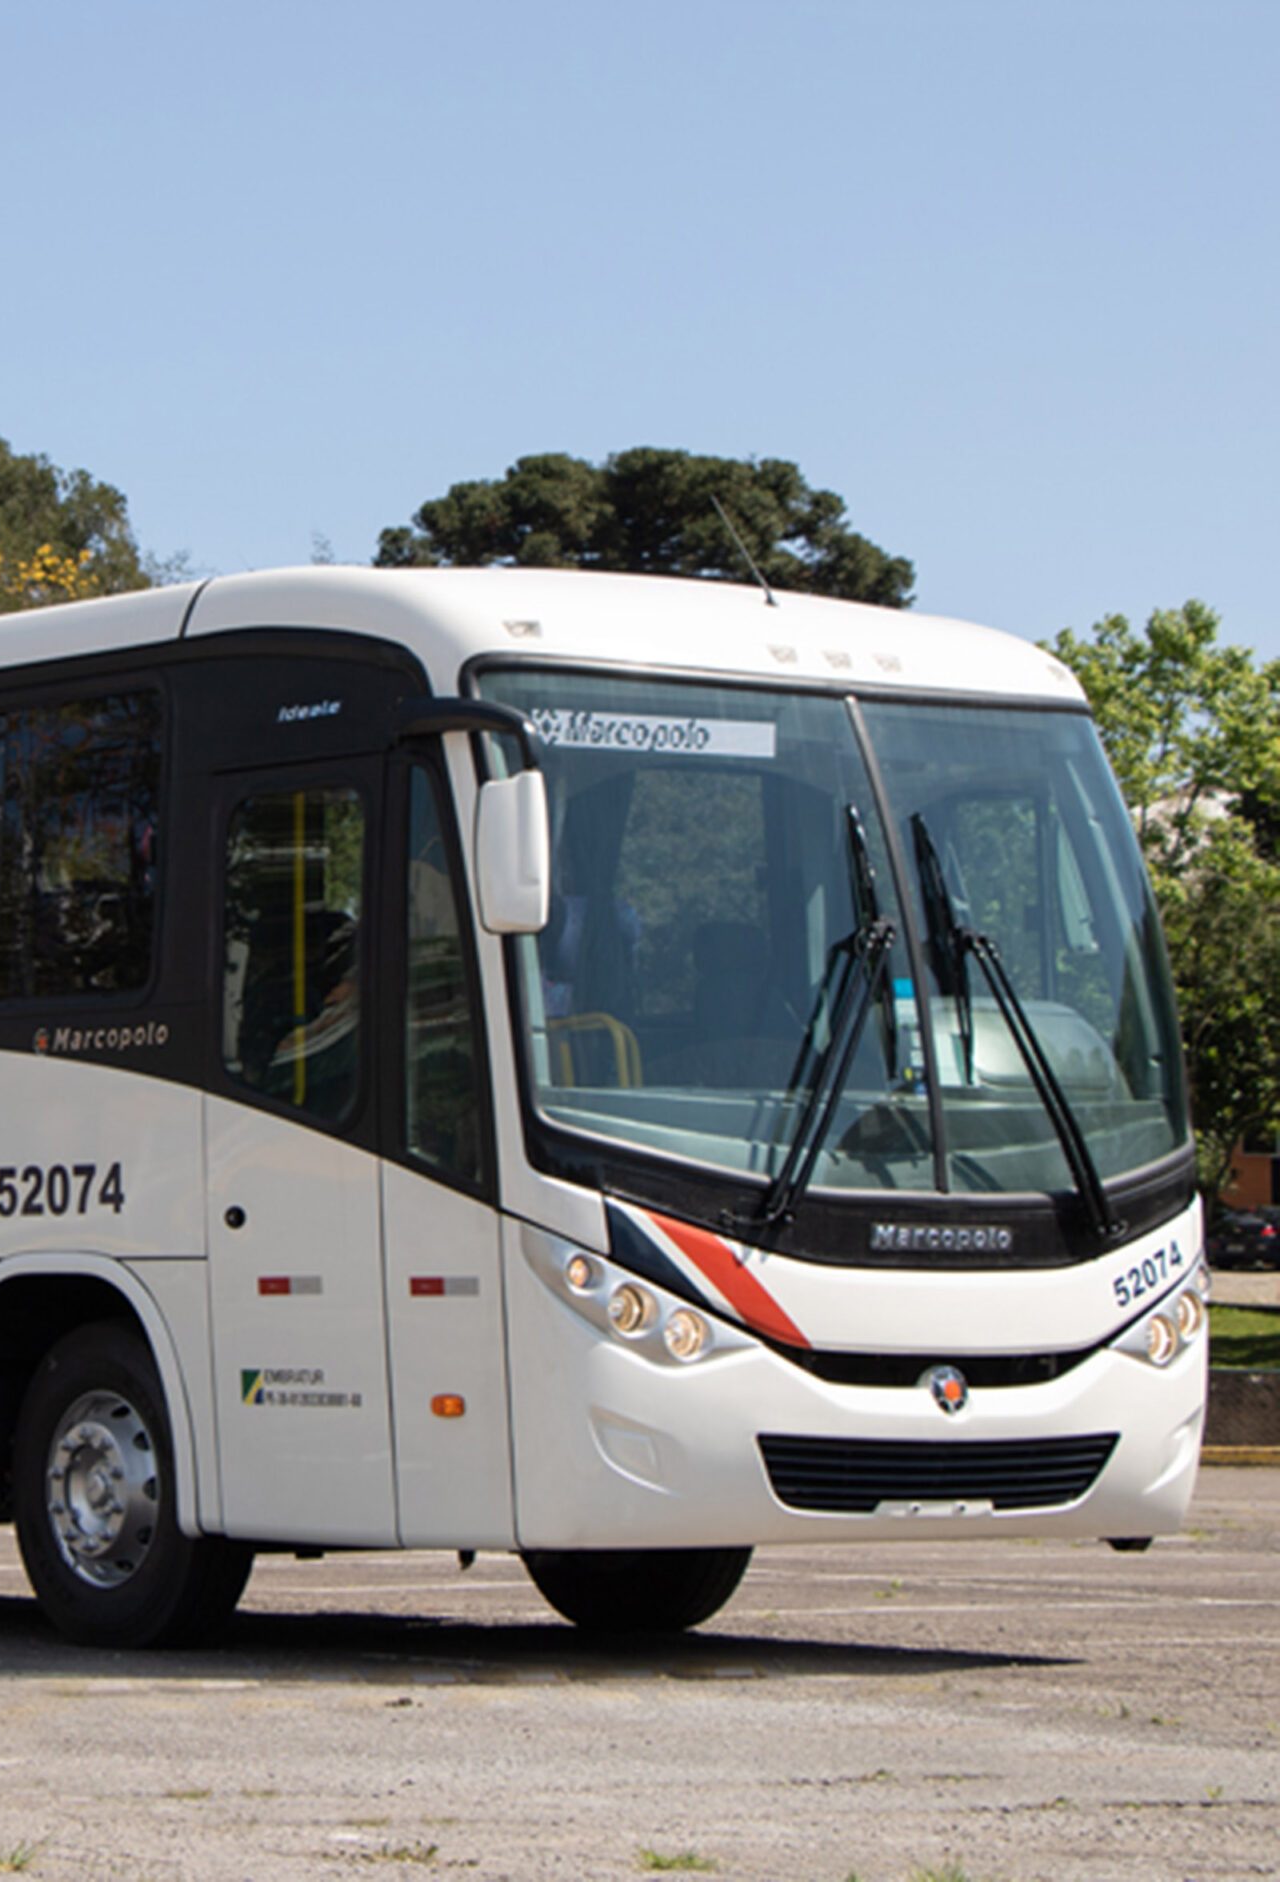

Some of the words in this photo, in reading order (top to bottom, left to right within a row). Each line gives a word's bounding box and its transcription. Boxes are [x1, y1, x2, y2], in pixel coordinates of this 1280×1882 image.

[564, 707, 710, 751] Marcopolo
[53, 1021, 169, 1051] Marcopolo
[872, 1223, 1012, 1250] Marcopolo
[1112, 1239, 1183, 1308] 52074
